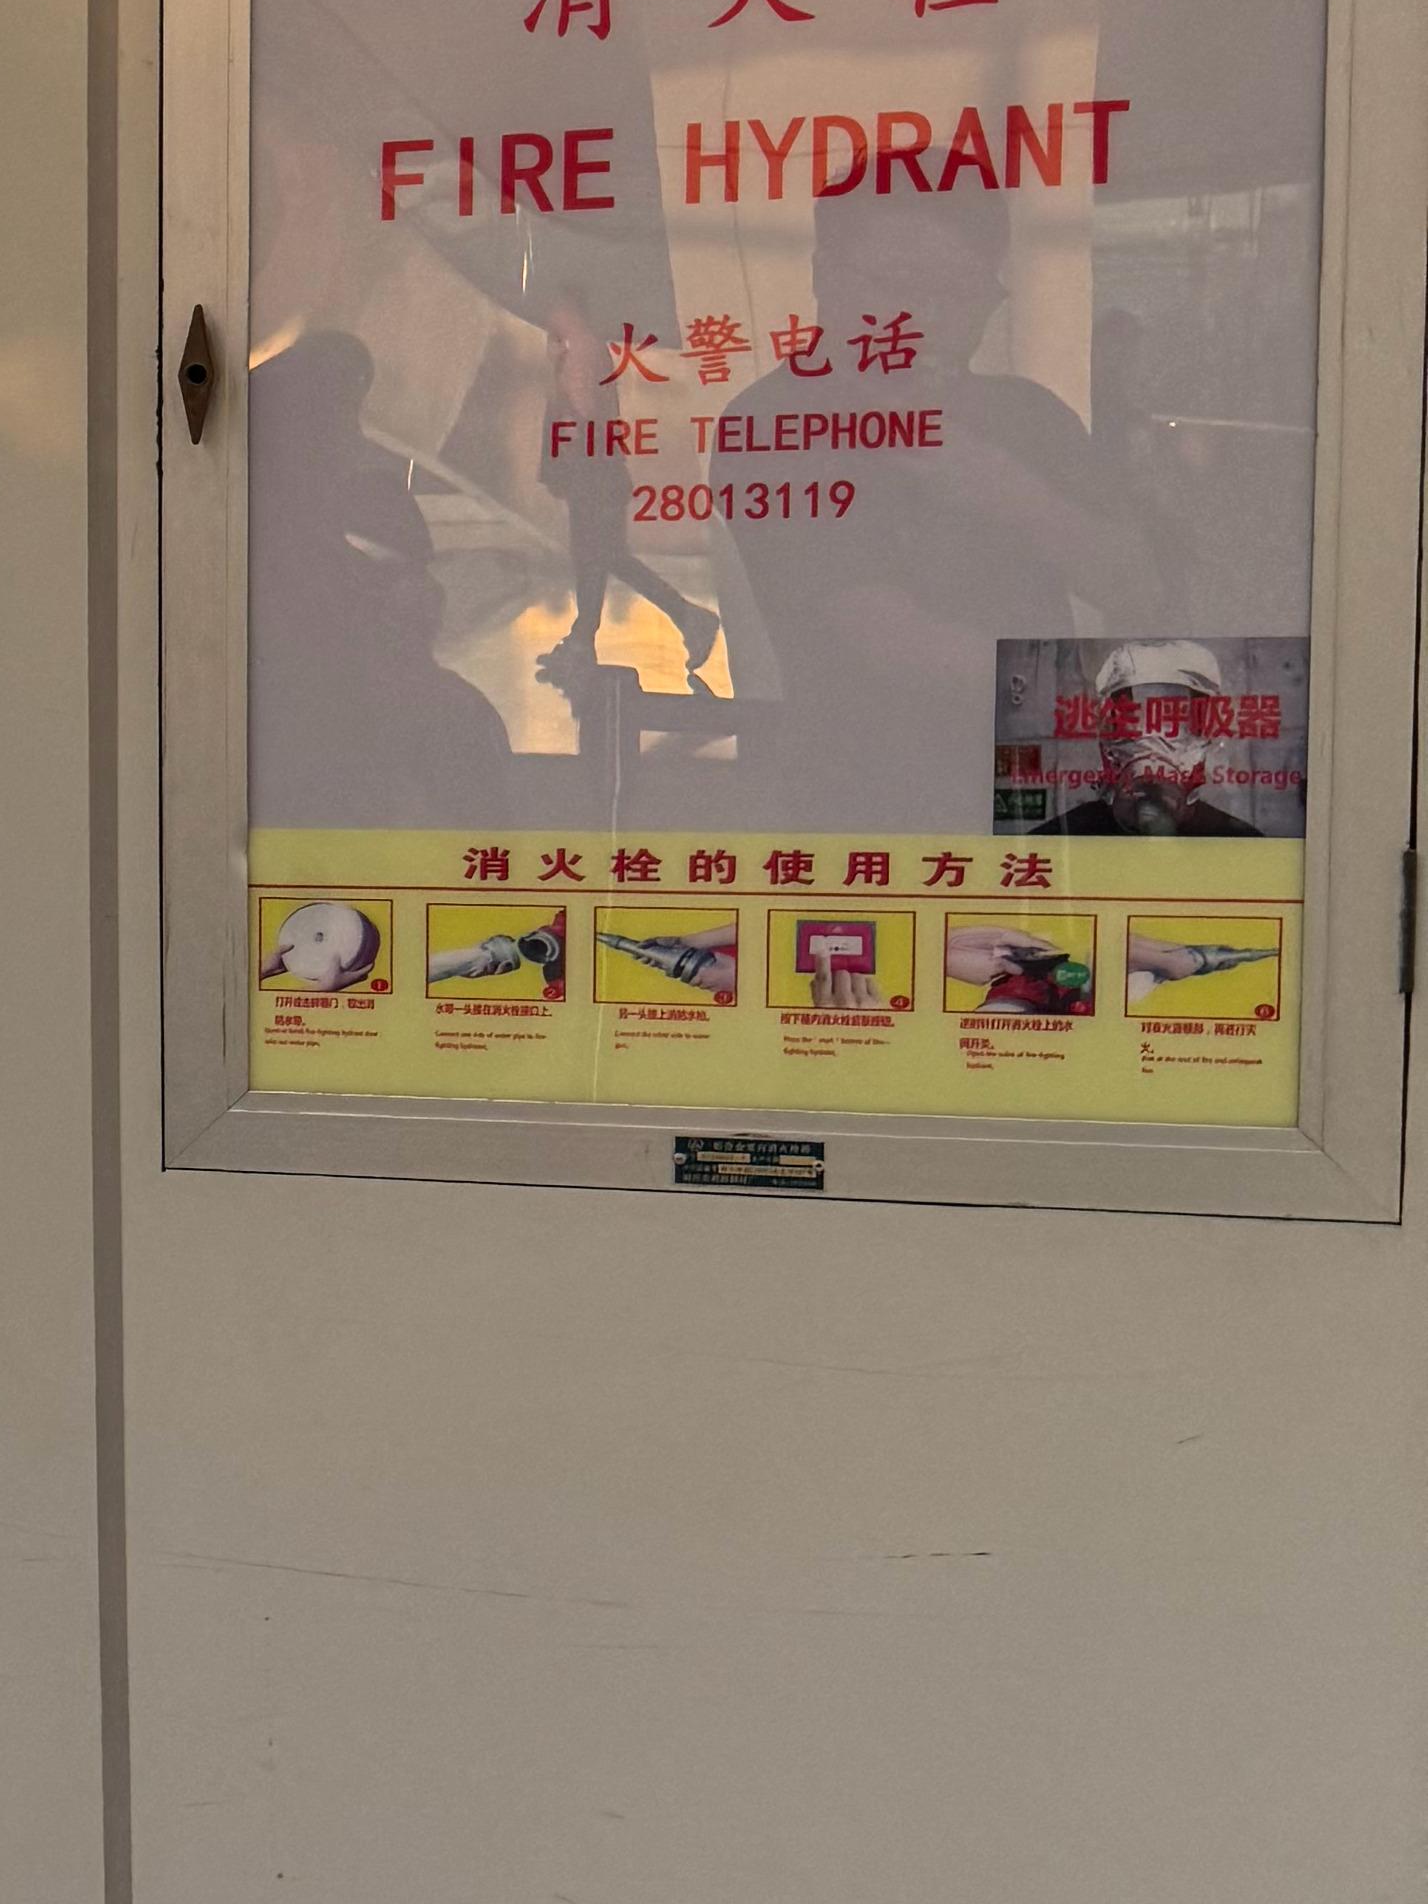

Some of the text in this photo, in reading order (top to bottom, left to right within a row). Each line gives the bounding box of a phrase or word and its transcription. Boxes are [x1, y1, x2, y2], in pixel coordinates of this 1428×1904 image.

[380, 99, 1130, 221] FIRE HYDRANT
[599, 311, 925, 387] 火警电话
[551, 409, 944, 458] FIRE TELEPHONE
[632, 480, 856, 522] 28013119
[1053, 691, 1282, 740] 逃生呼吸器
[1212, 765, 1301, 790] Storage
[462, 846, 1054, 889] 消火栓的使用方法
